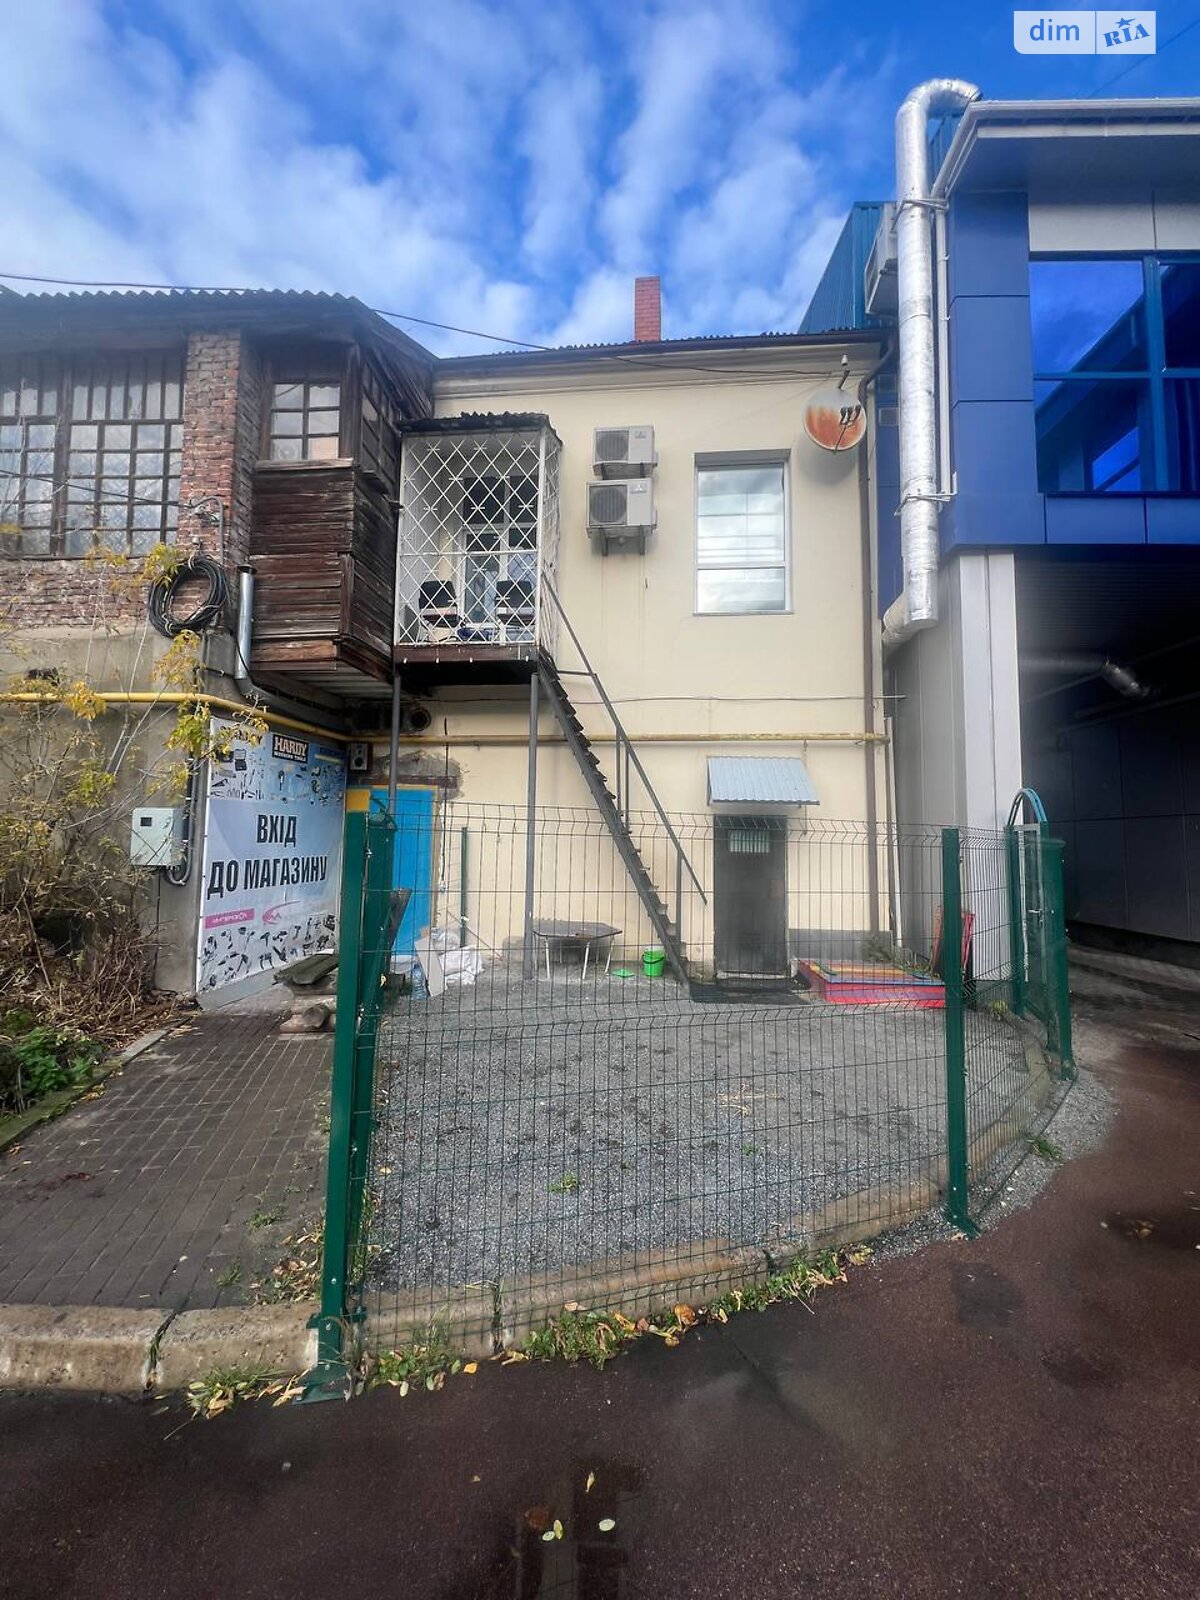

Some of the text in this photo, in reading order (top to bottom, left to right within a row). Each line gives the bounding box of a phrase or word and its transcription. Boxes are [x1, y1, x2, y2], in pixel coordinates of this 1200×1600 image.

[274, 736, 307, 757] HARDY
[256, 814, 297, 848] ВХІД
[206, 855, 328, 901] ДО МАГАЗИНУ
